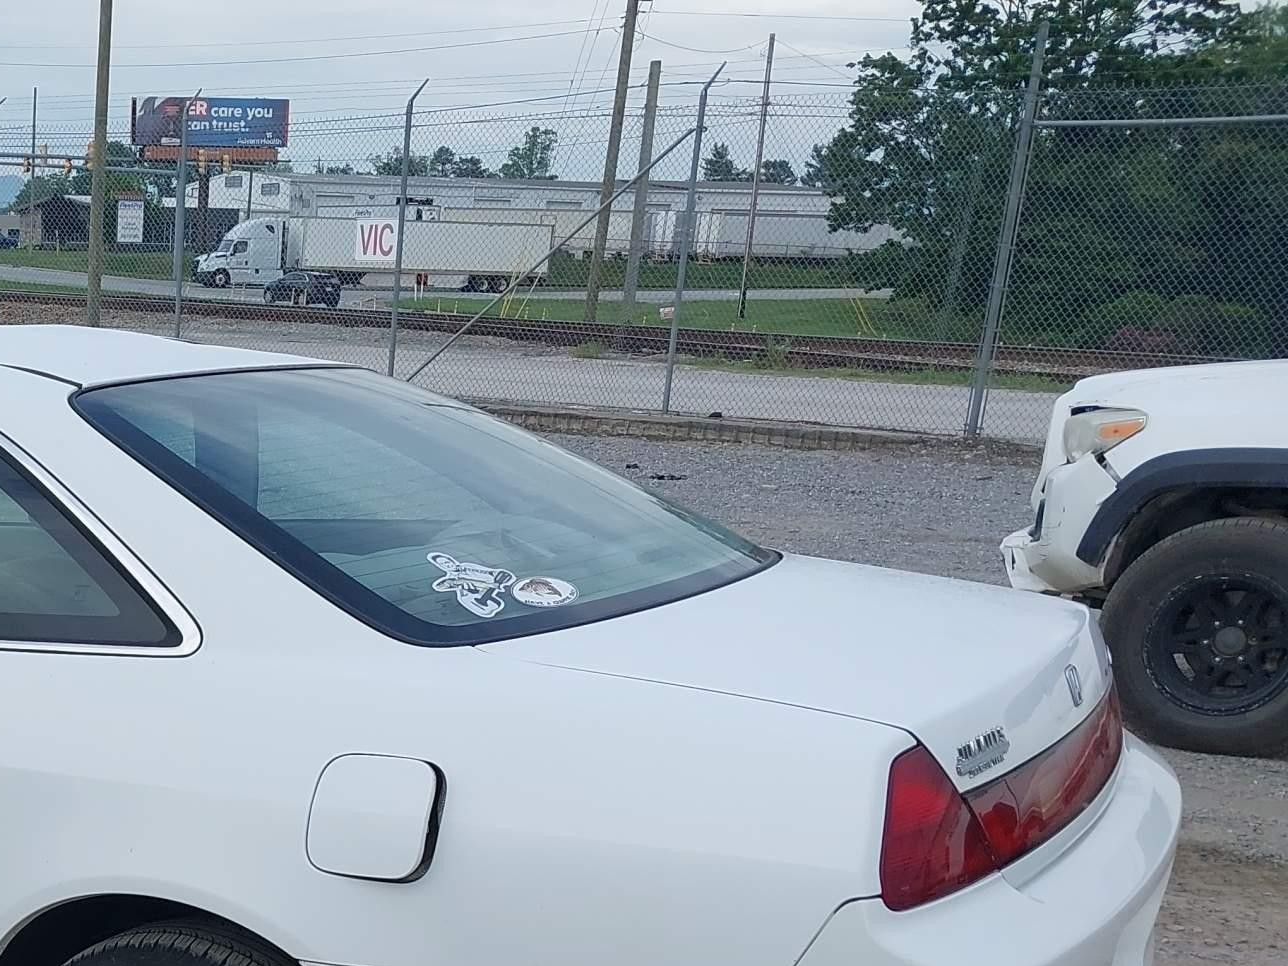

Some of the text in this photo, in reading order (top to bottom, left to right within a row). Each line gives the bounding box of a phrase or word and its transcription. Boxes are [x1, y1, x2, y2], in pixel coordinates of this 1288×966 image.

[186, 100, 273, 120] ER care you
[212, 119, 249, 132] trust.
[359, 223, 394, 257] VIC
